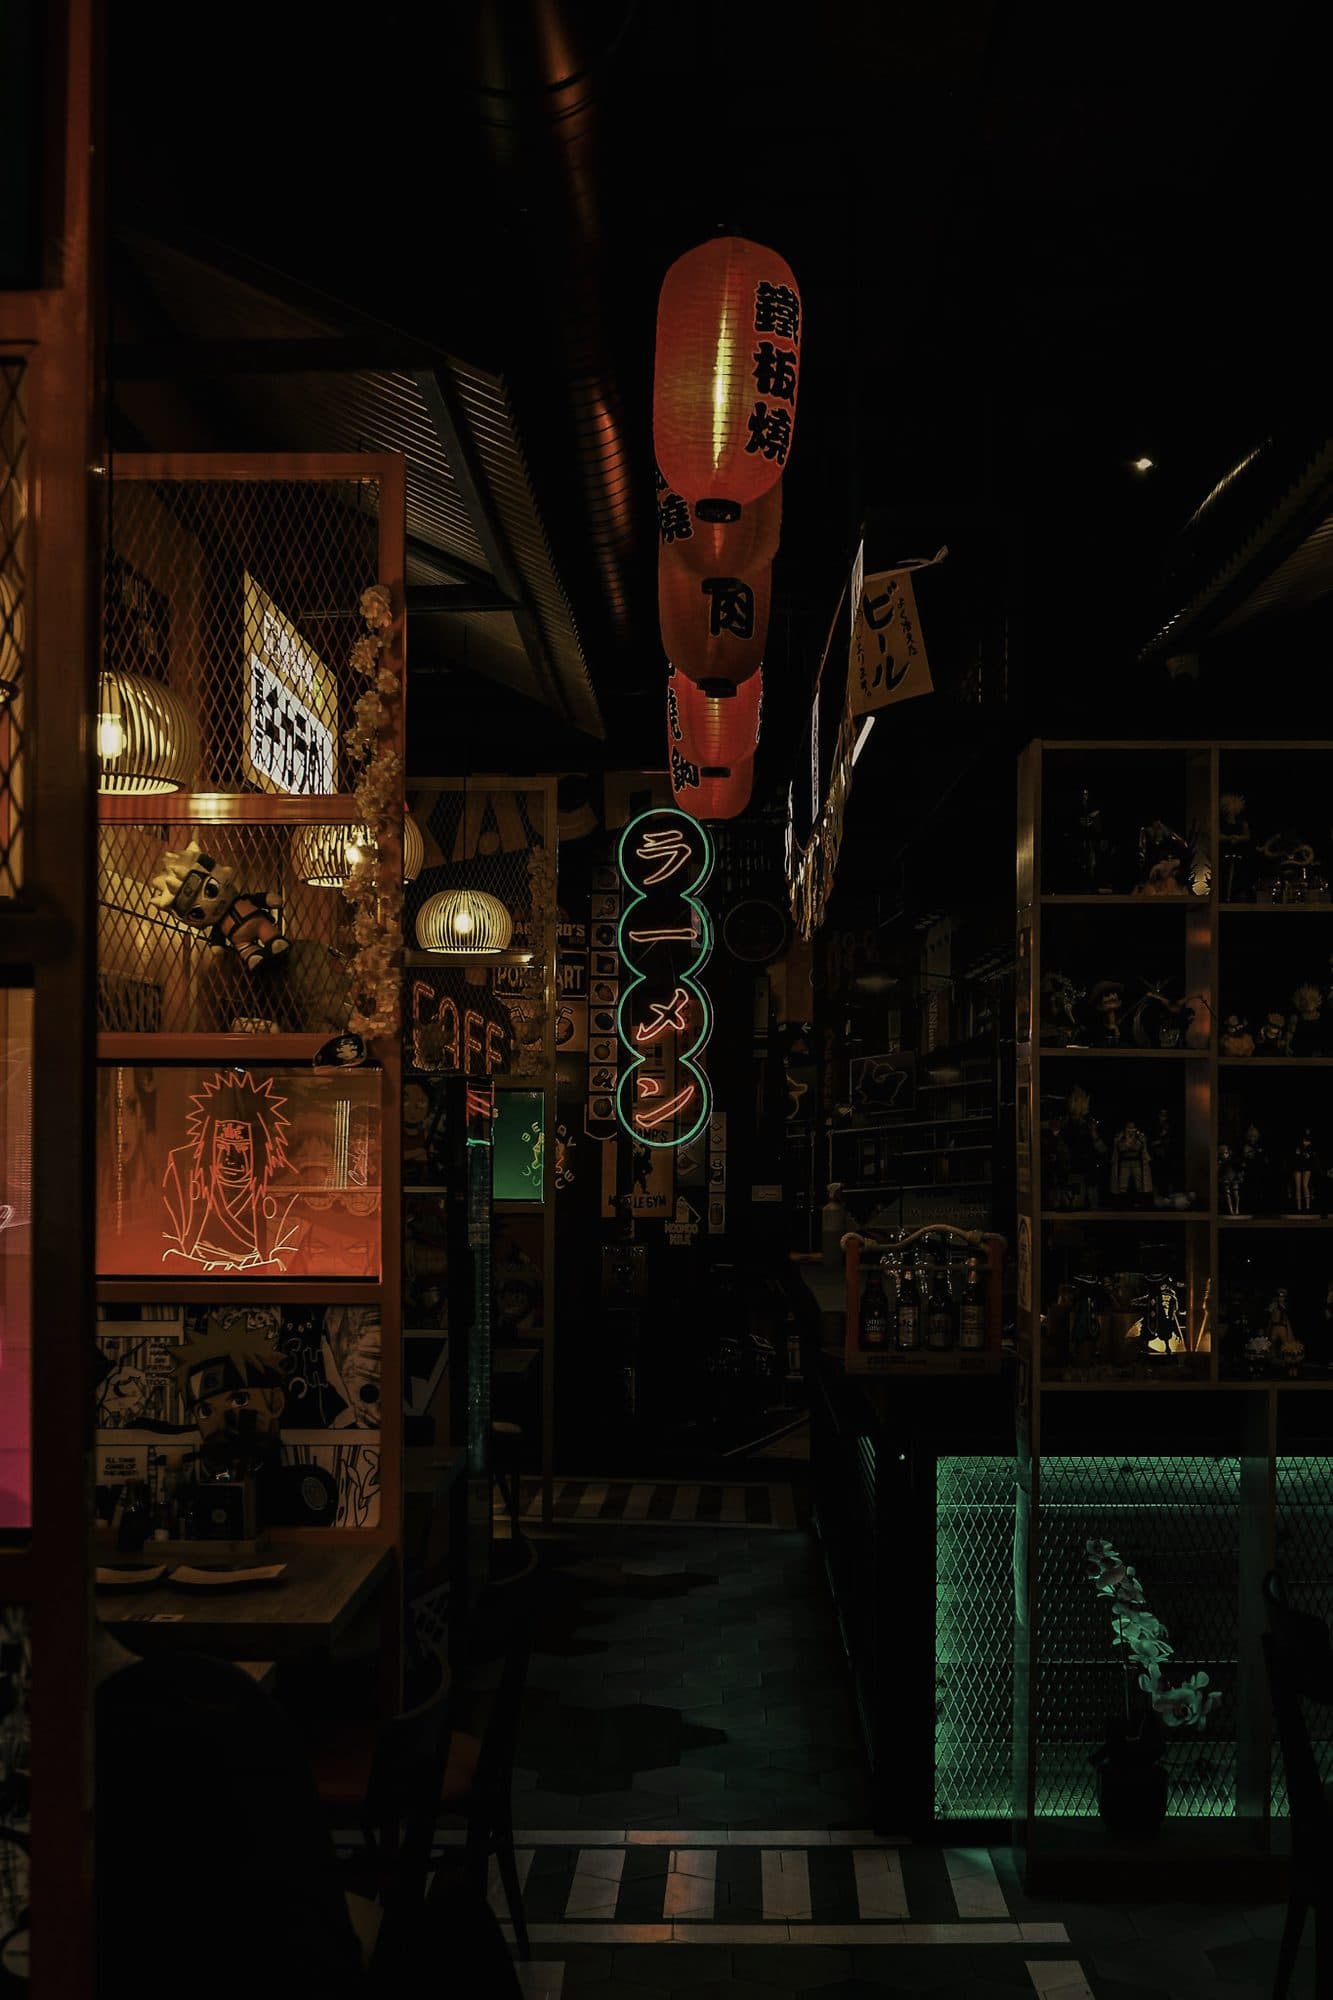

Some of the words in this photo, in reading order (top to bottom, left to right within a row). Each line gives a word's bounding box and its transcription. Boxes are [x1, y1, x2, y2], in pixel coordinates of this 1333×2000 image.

[863, 580, 912, 691] ビール
[628, 829, 699, 1128] ラーメン
